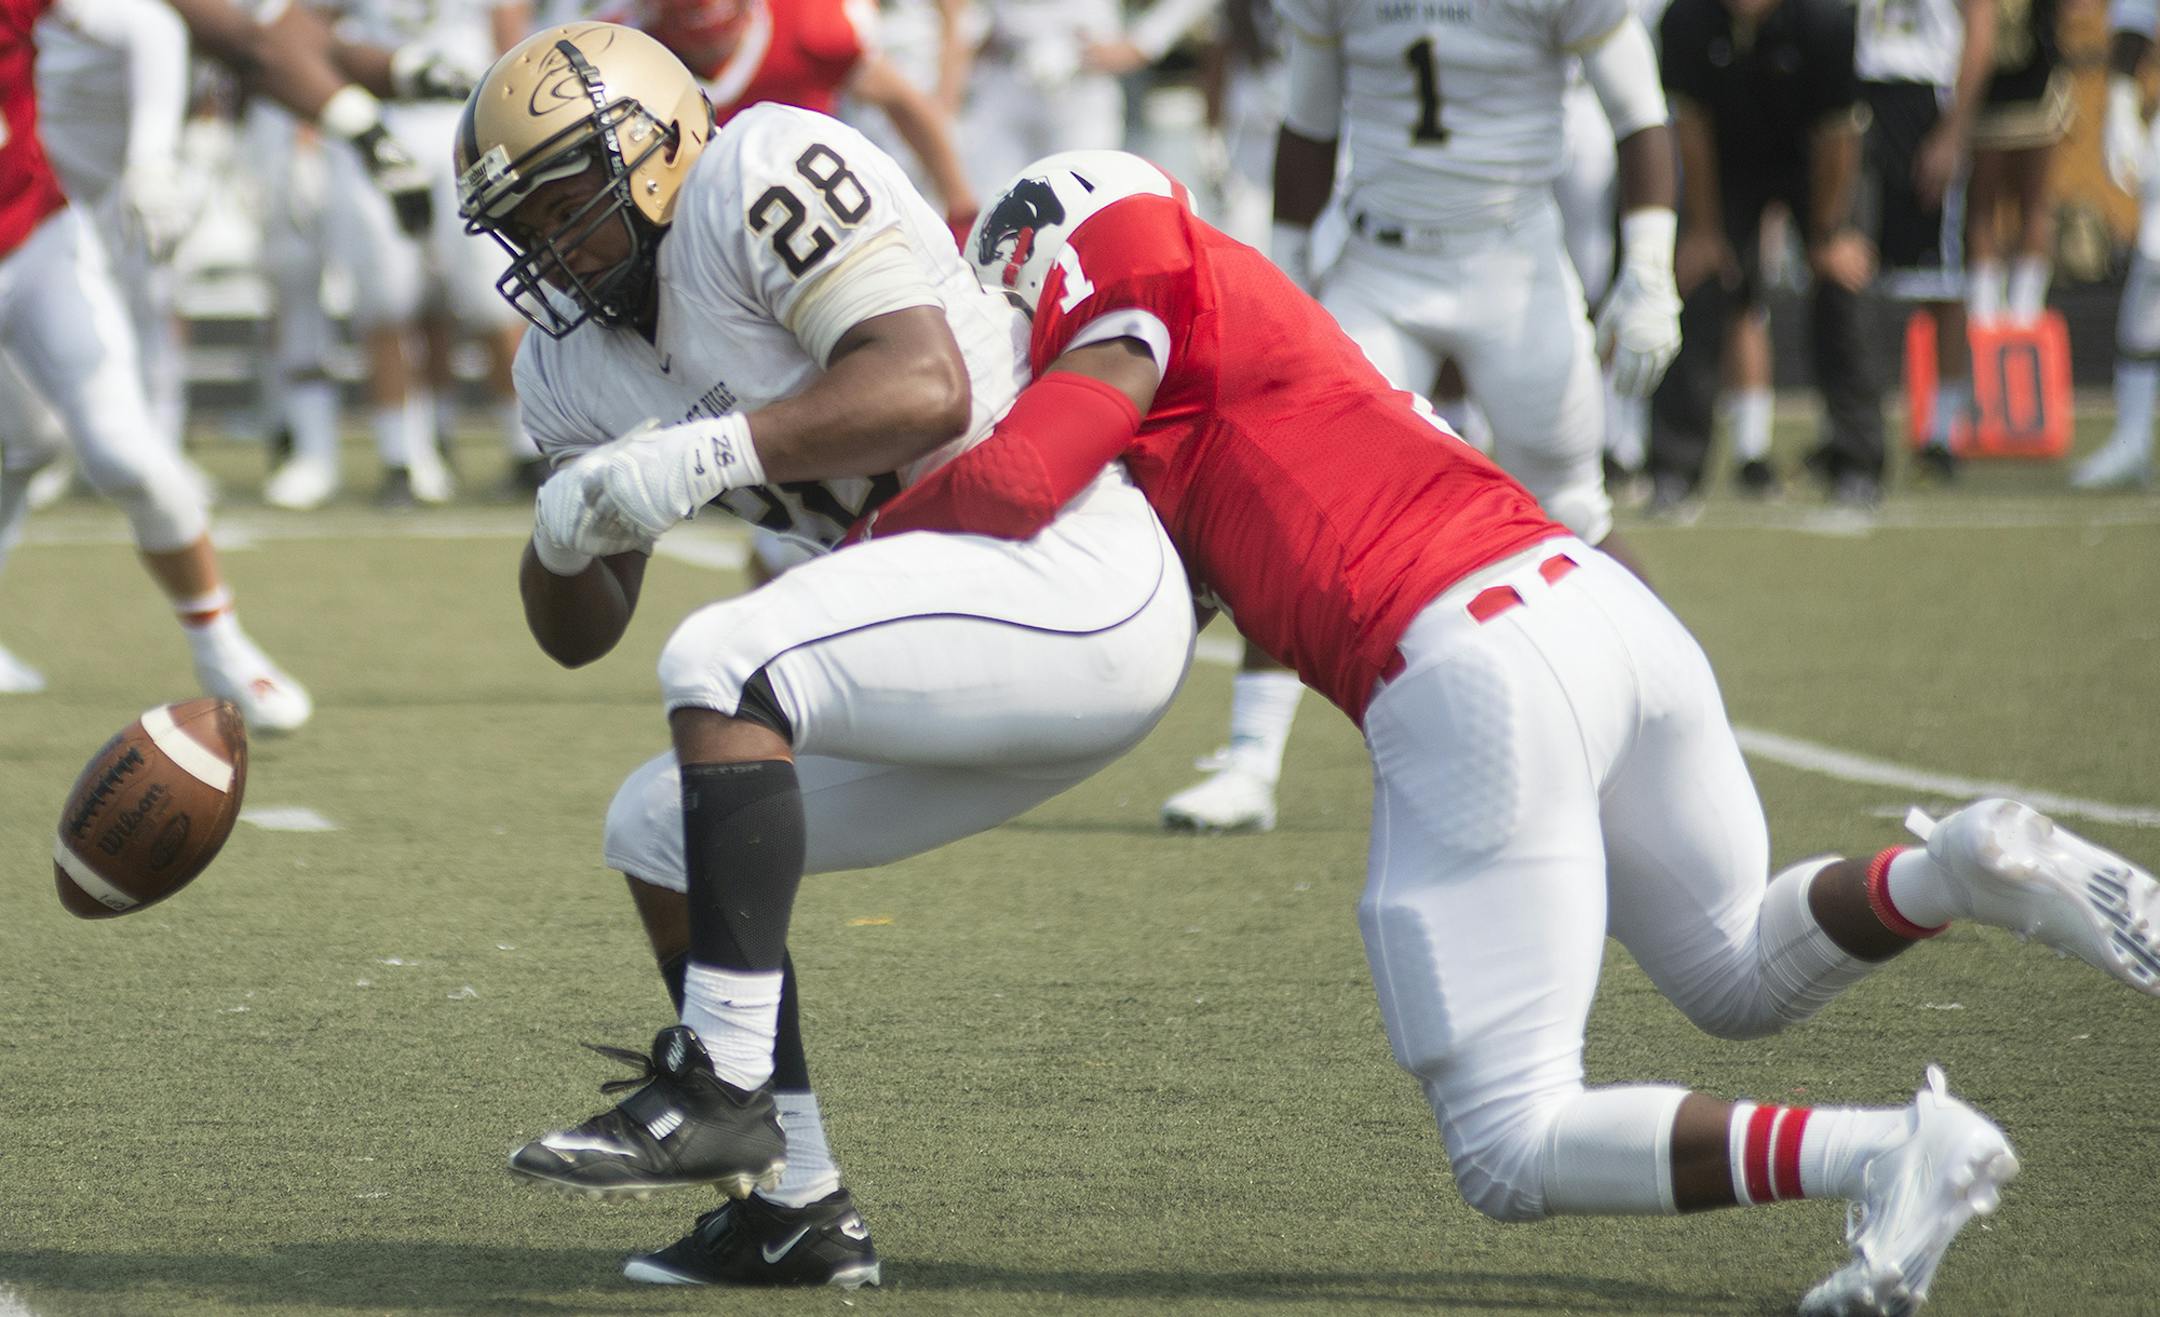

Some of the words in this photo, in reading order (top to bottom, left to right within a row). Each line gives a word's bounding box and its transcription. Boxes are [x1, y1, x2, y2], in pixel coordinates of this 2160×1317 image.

[1405, 38, 1449, 147] 1
[748, 143, 870, 278] 28
[1058, 240, 1096, 315] 1
[711, 434, 736, 468] 28
[100, 783, 167, 856] Wilson
